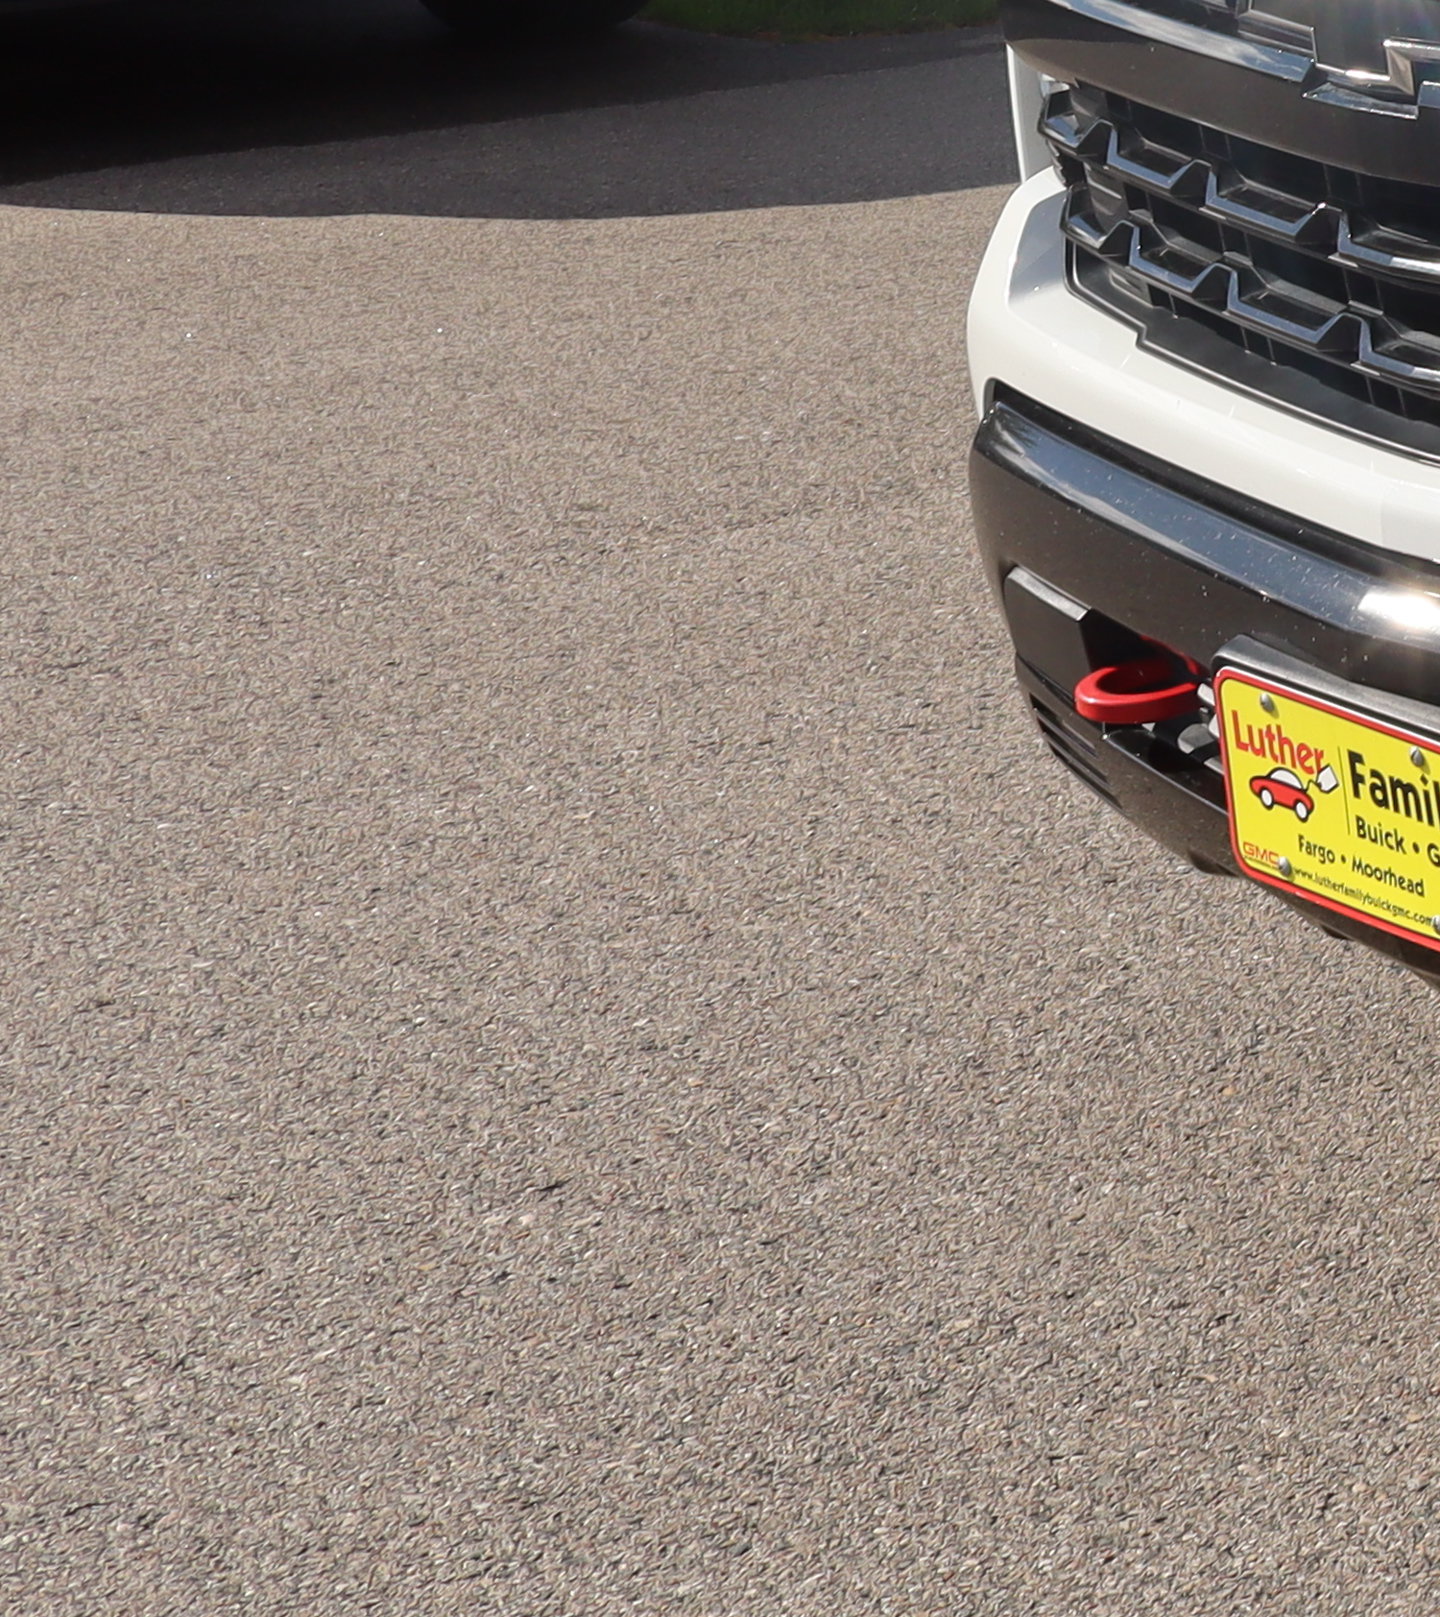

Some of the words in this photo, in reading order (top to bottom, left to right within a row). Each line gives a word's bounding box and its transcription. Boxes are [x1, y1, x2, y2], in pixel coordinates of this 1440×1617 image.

[1231, 710, 1324, 775] Luther
[1243, 842, 1280, 864] GMC
[1356, 815, 1406, 855] Buick
[1298, 834, 1335, 864] Fargo
[1352, 855, 1425, 897] Moorhead
